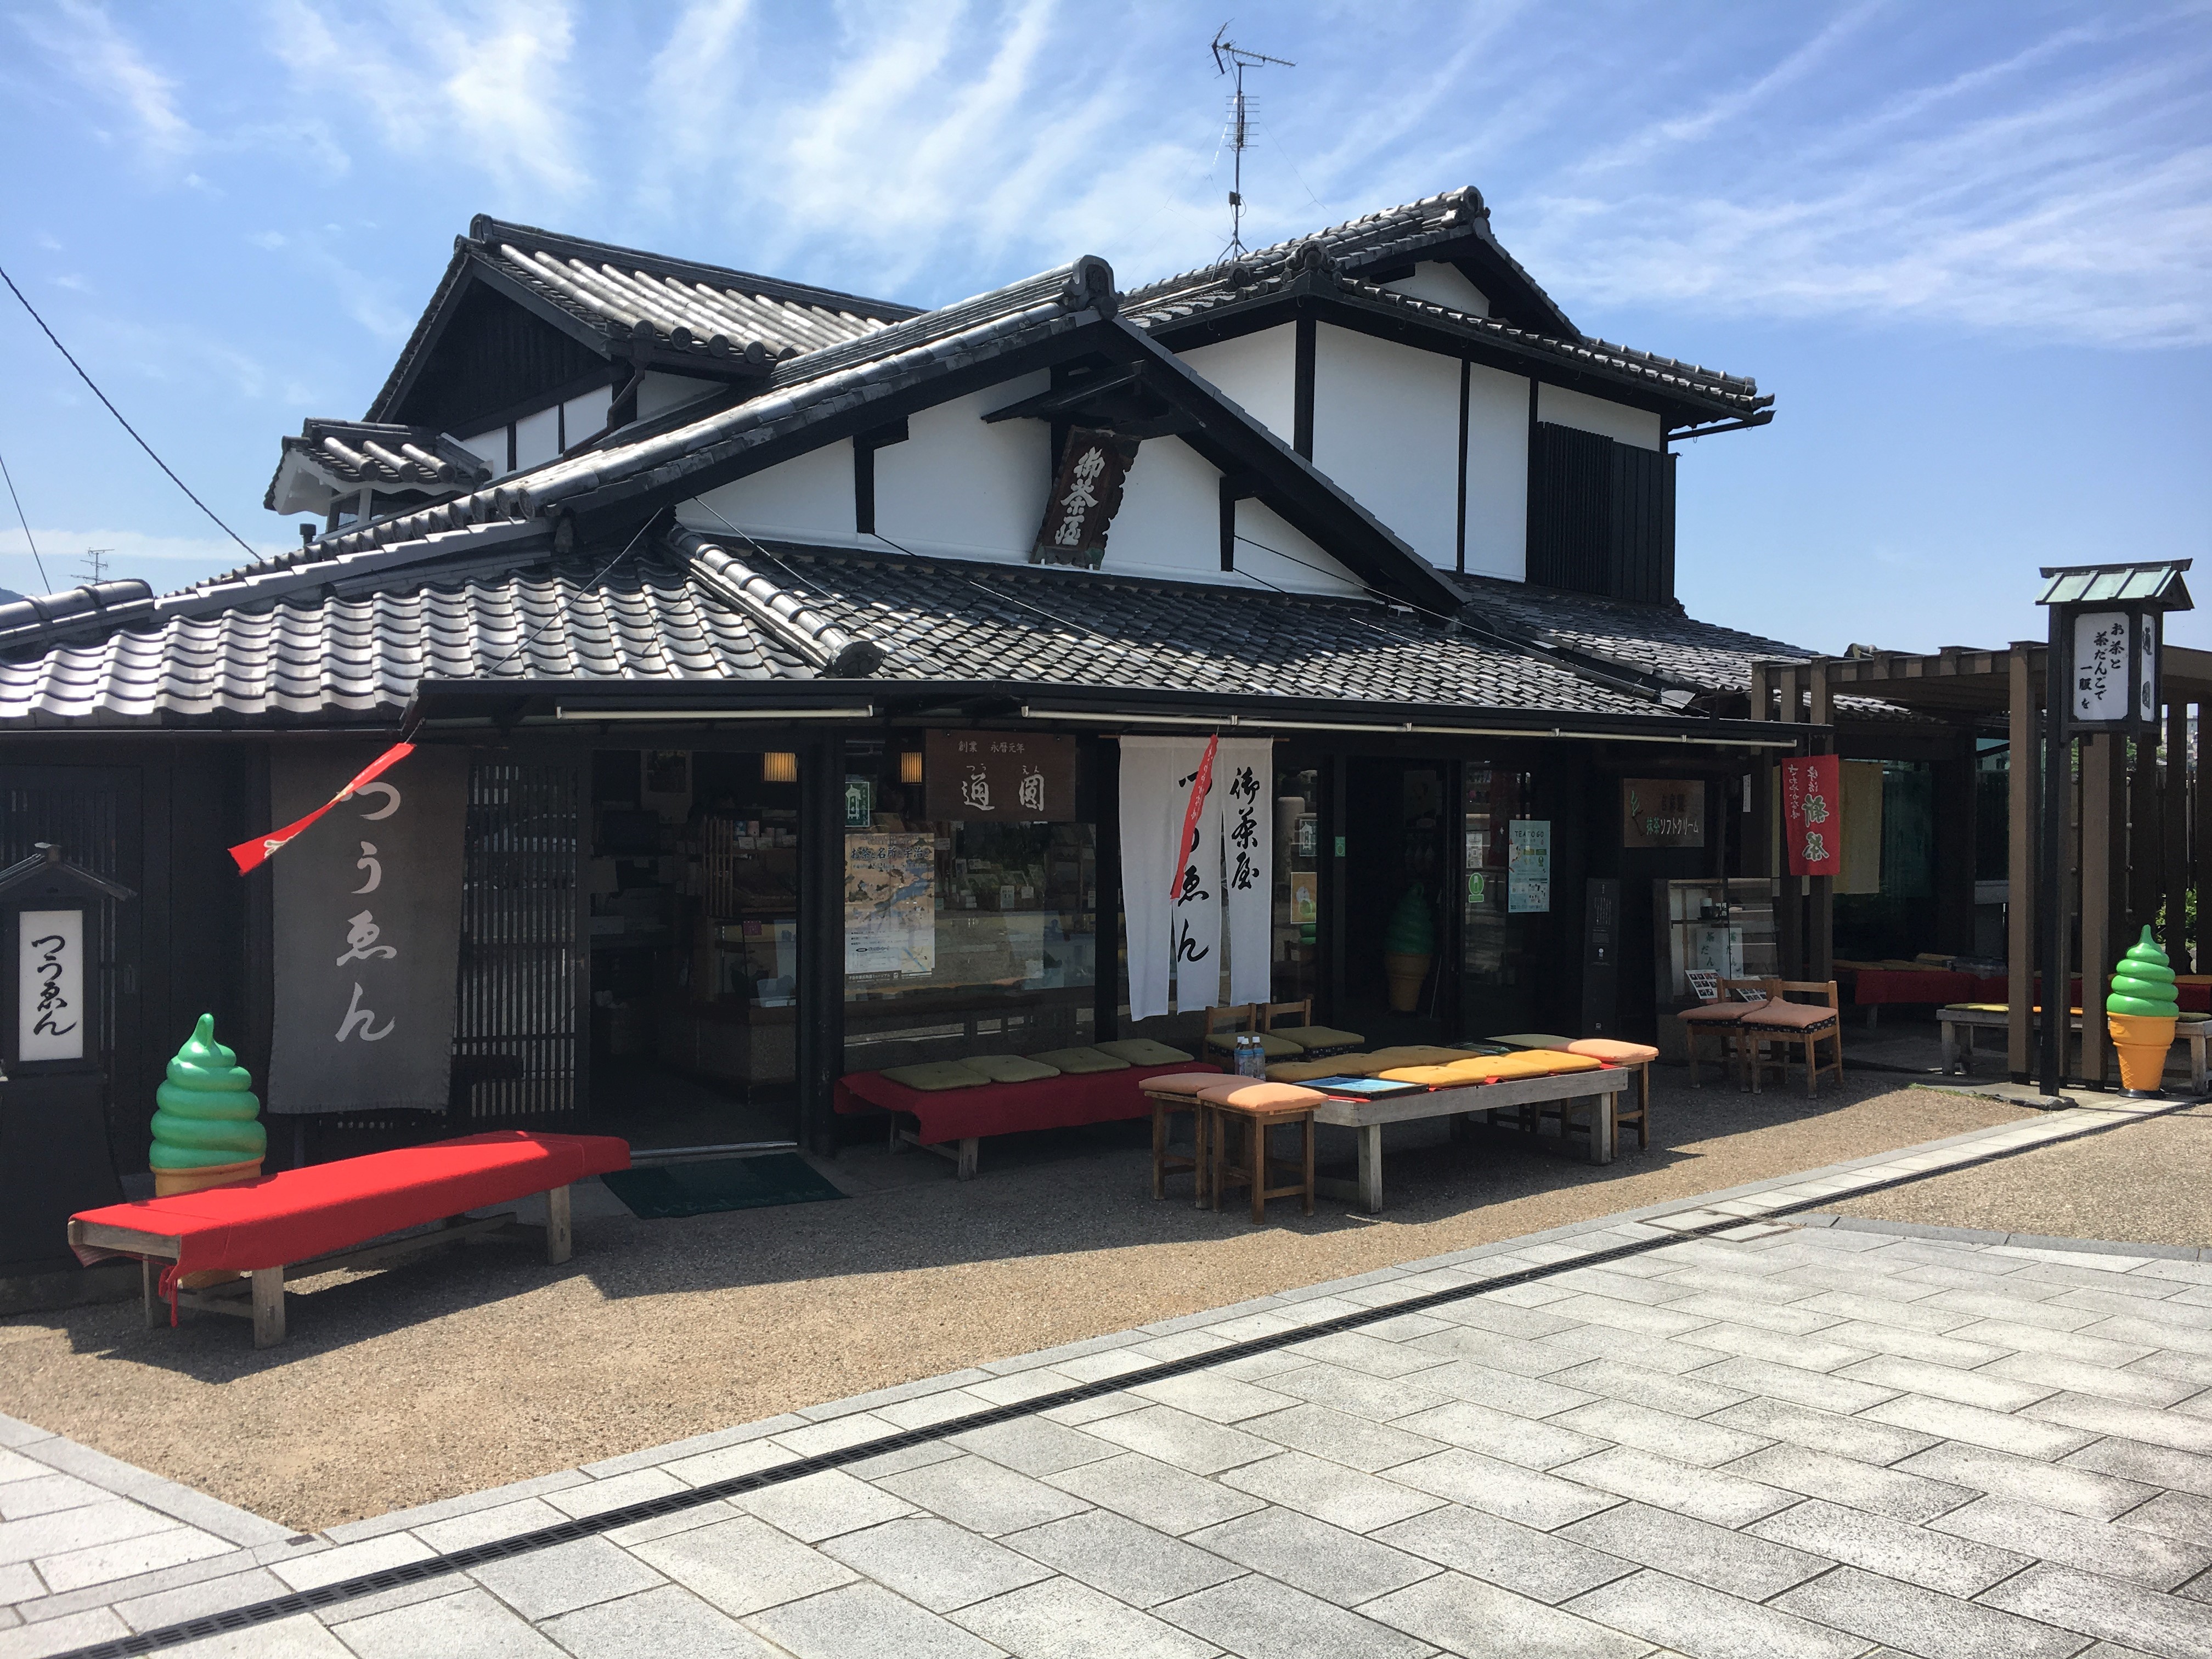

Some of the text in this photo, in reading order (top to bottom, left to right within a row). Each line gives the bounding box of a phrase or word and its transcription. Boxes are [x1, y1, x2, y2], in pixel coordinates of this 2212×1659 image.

[1054, 446, 1105, 545] 御茶屋
[2093, 631, 2109, 701] 茶だんごで
[2108, 623, 2125, 669] お茶と
[2079, 665, 2093, 709] 一服を
[958, 741, 977, 753] 創業
[1229, 766, 1261, 890] 御茶屋
[1646, 816, 1699, 836] 抹茶ソフトクリーム
[335, 782, 401, 1042] つうゑん
[31, 935, 76, 1036] つうゑん
